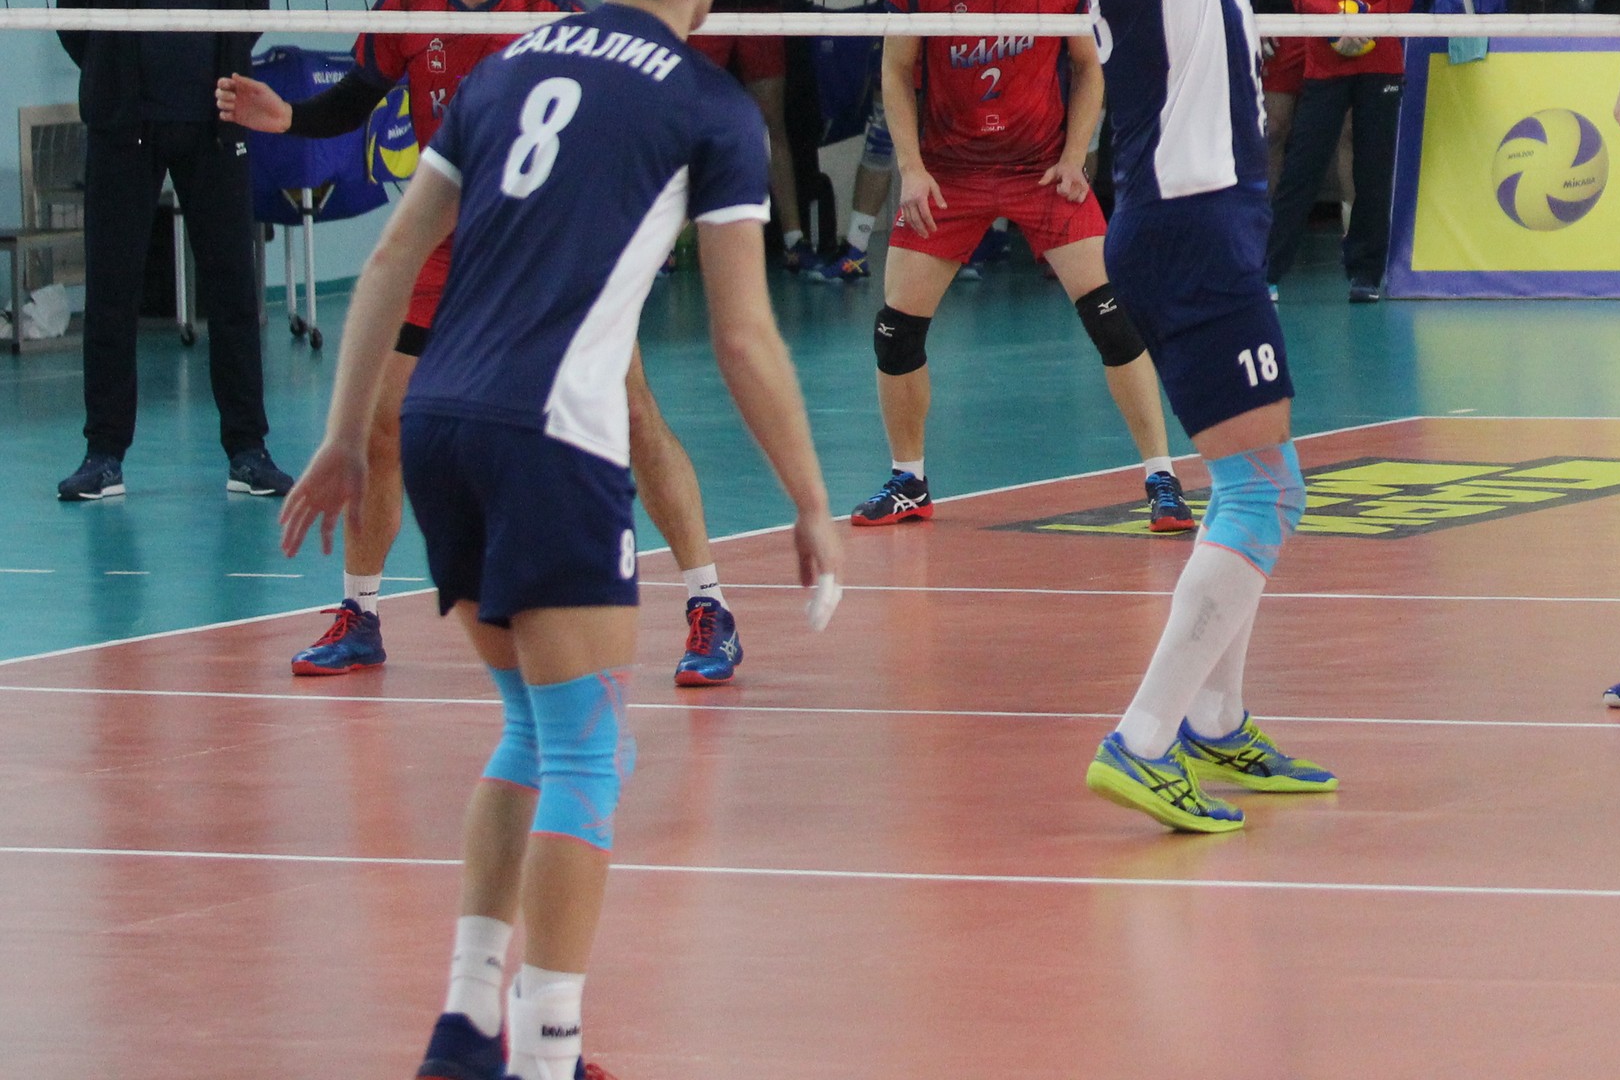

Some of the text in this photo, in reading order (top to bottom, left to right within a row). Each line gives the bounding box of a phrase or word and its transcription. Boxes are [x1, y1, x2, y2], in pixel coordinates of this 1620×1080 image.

[503, 25, 682, 82] САХАЛИН
[950, 34, 1036, 69] КАМА
[980, 67, 1002, 102] 2
[502, 76, 582, 199] 8
[1238, 343, 1279, 387] 18
[619, 528, 635, 579] 8
